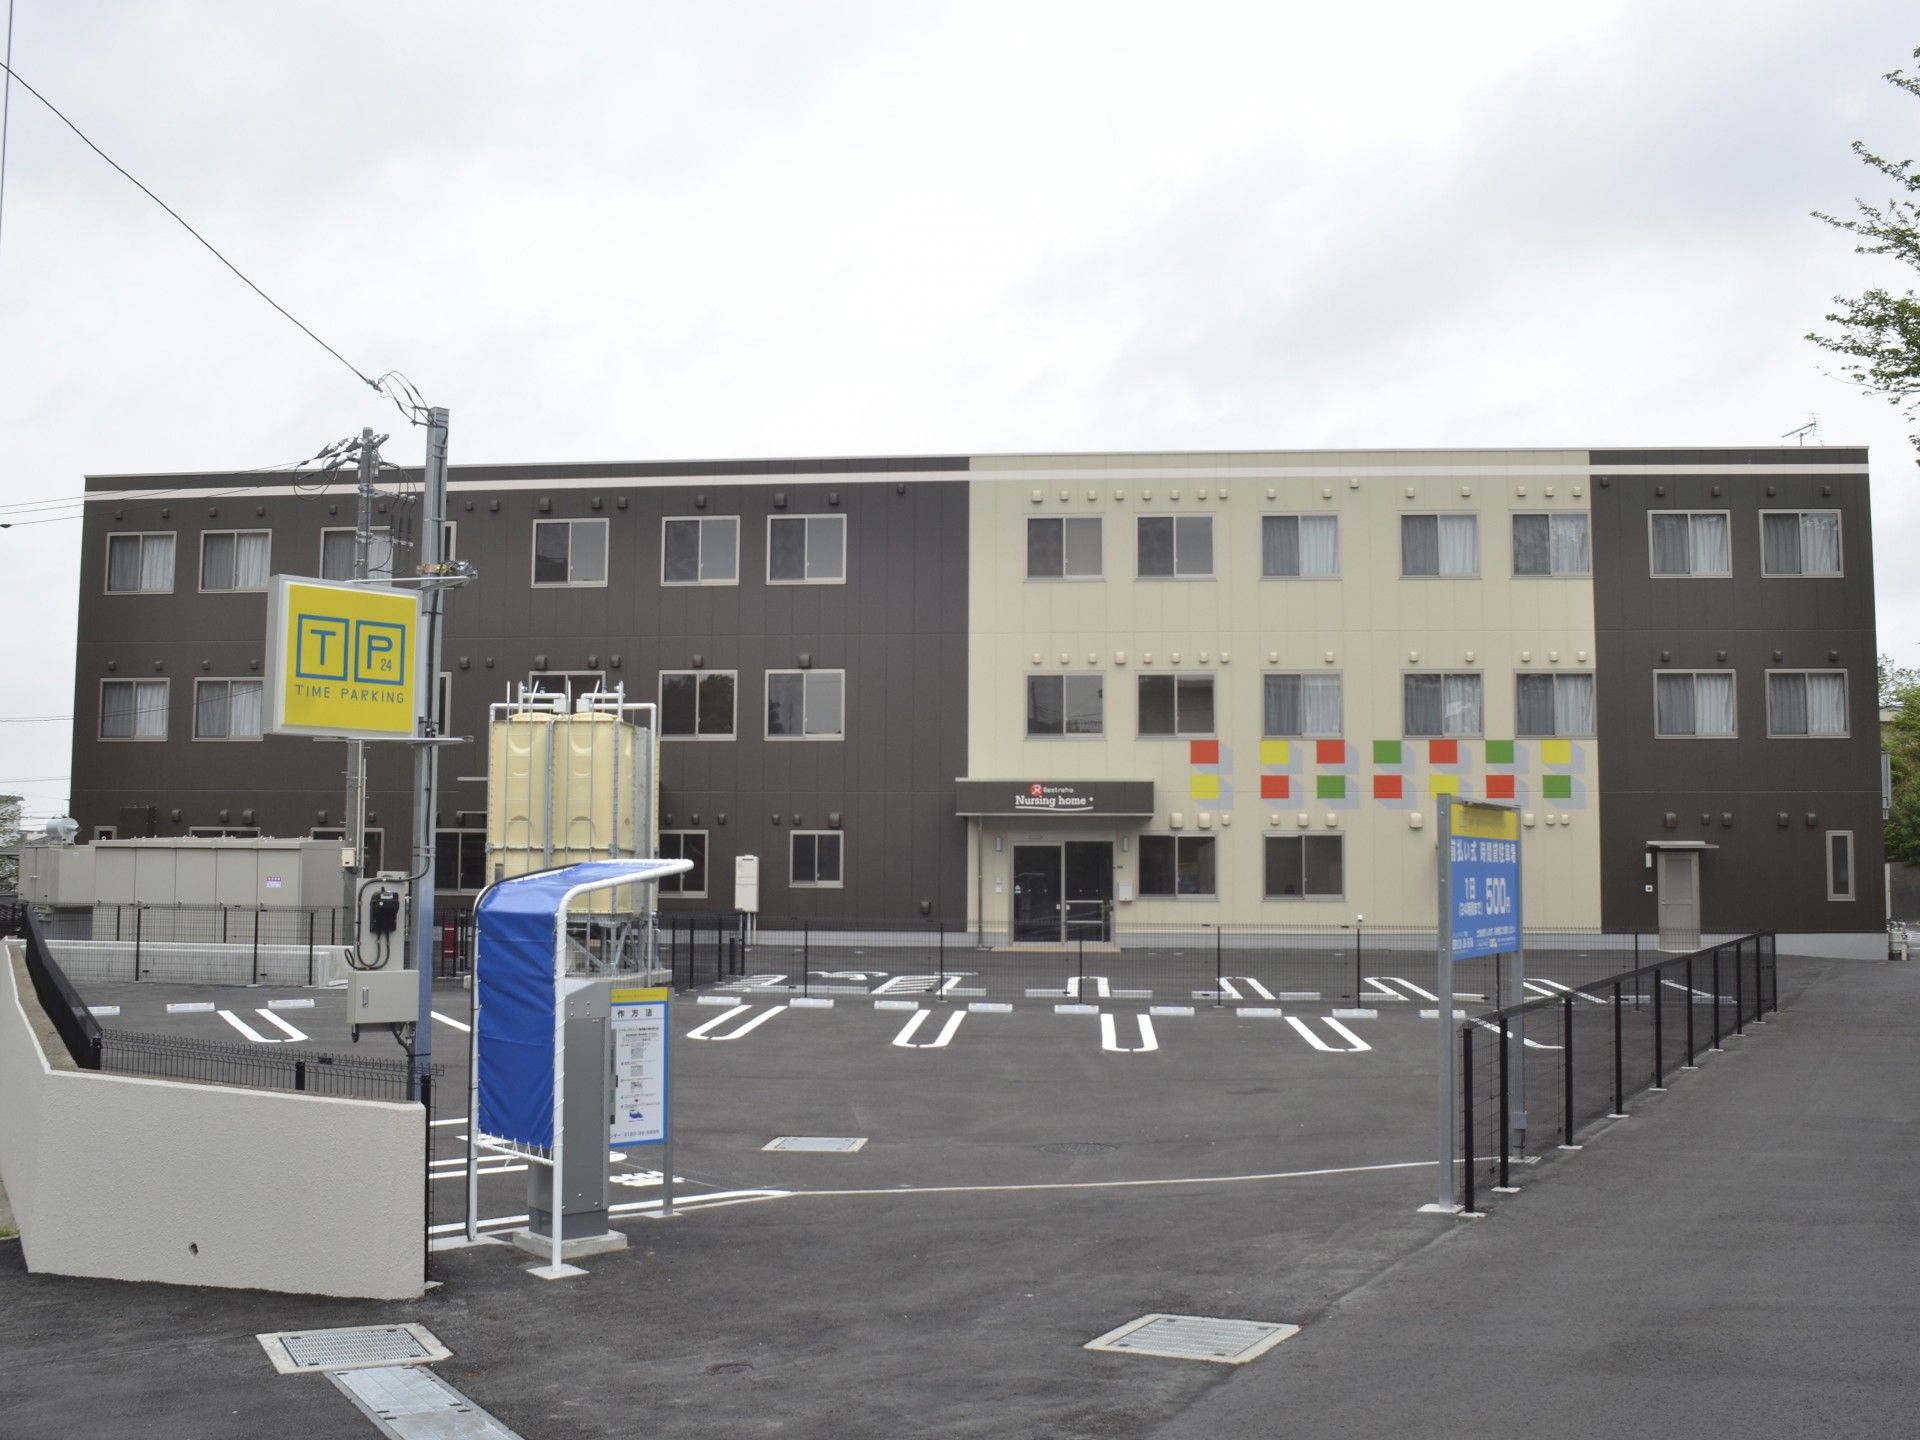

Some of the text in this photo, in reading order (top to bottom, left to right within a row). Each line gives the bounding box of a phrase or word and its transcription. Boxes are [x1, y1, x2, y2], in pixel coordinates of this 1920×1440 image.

[310, 628, 393, 670] T P
[380, 658, 392, 672] 24
[295, 684, 405, 704] TIME PARKING
[1015, 795, 1086, 807] Nursing home
[1464, 877, 1476, 900] 1日
